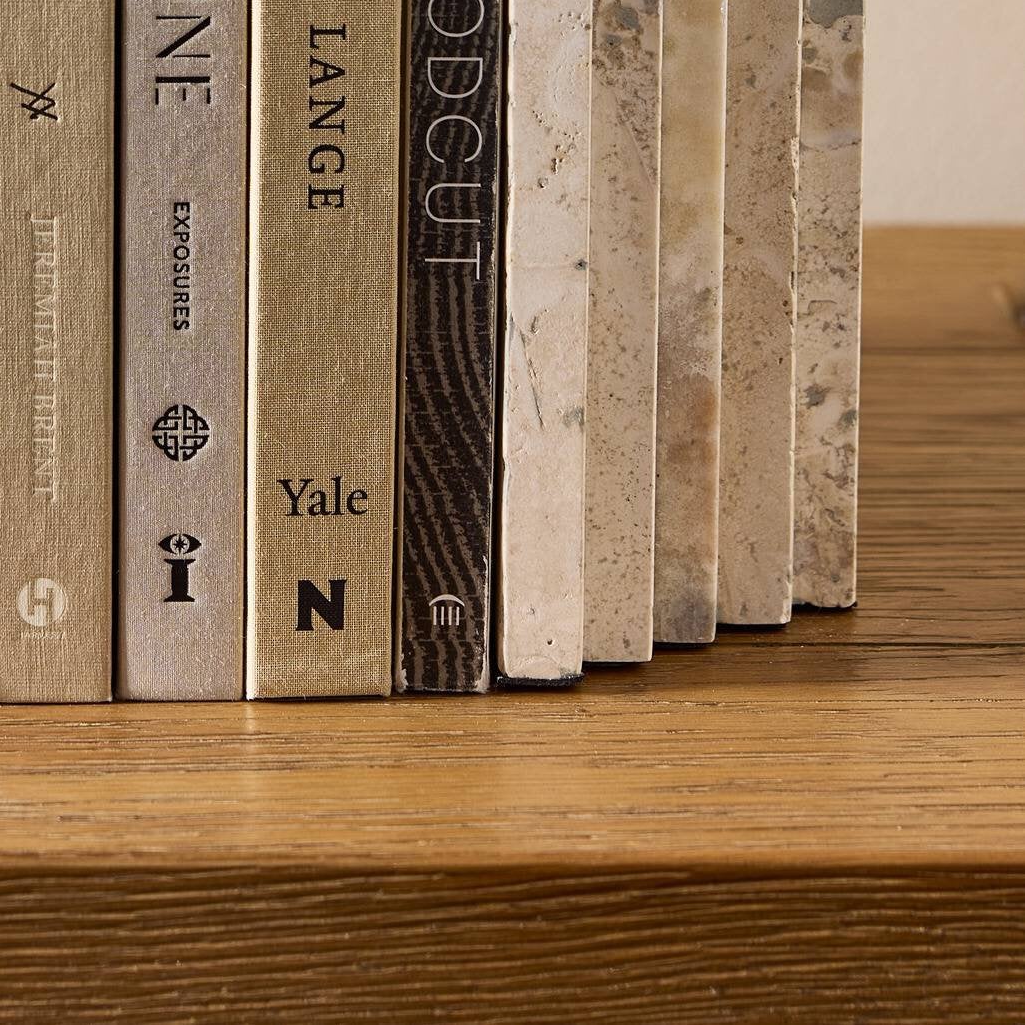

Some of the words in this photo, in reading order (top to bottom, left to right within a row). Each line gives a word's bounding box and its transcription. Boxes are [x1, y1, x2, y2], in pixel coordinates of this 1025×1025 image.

[307, 24, 346, 210] LANGE
[173, 202, 190, 331] EXPOSURES
[32, 394, 57, 503] BRENT
[277, 476, 368, 516] Yale
